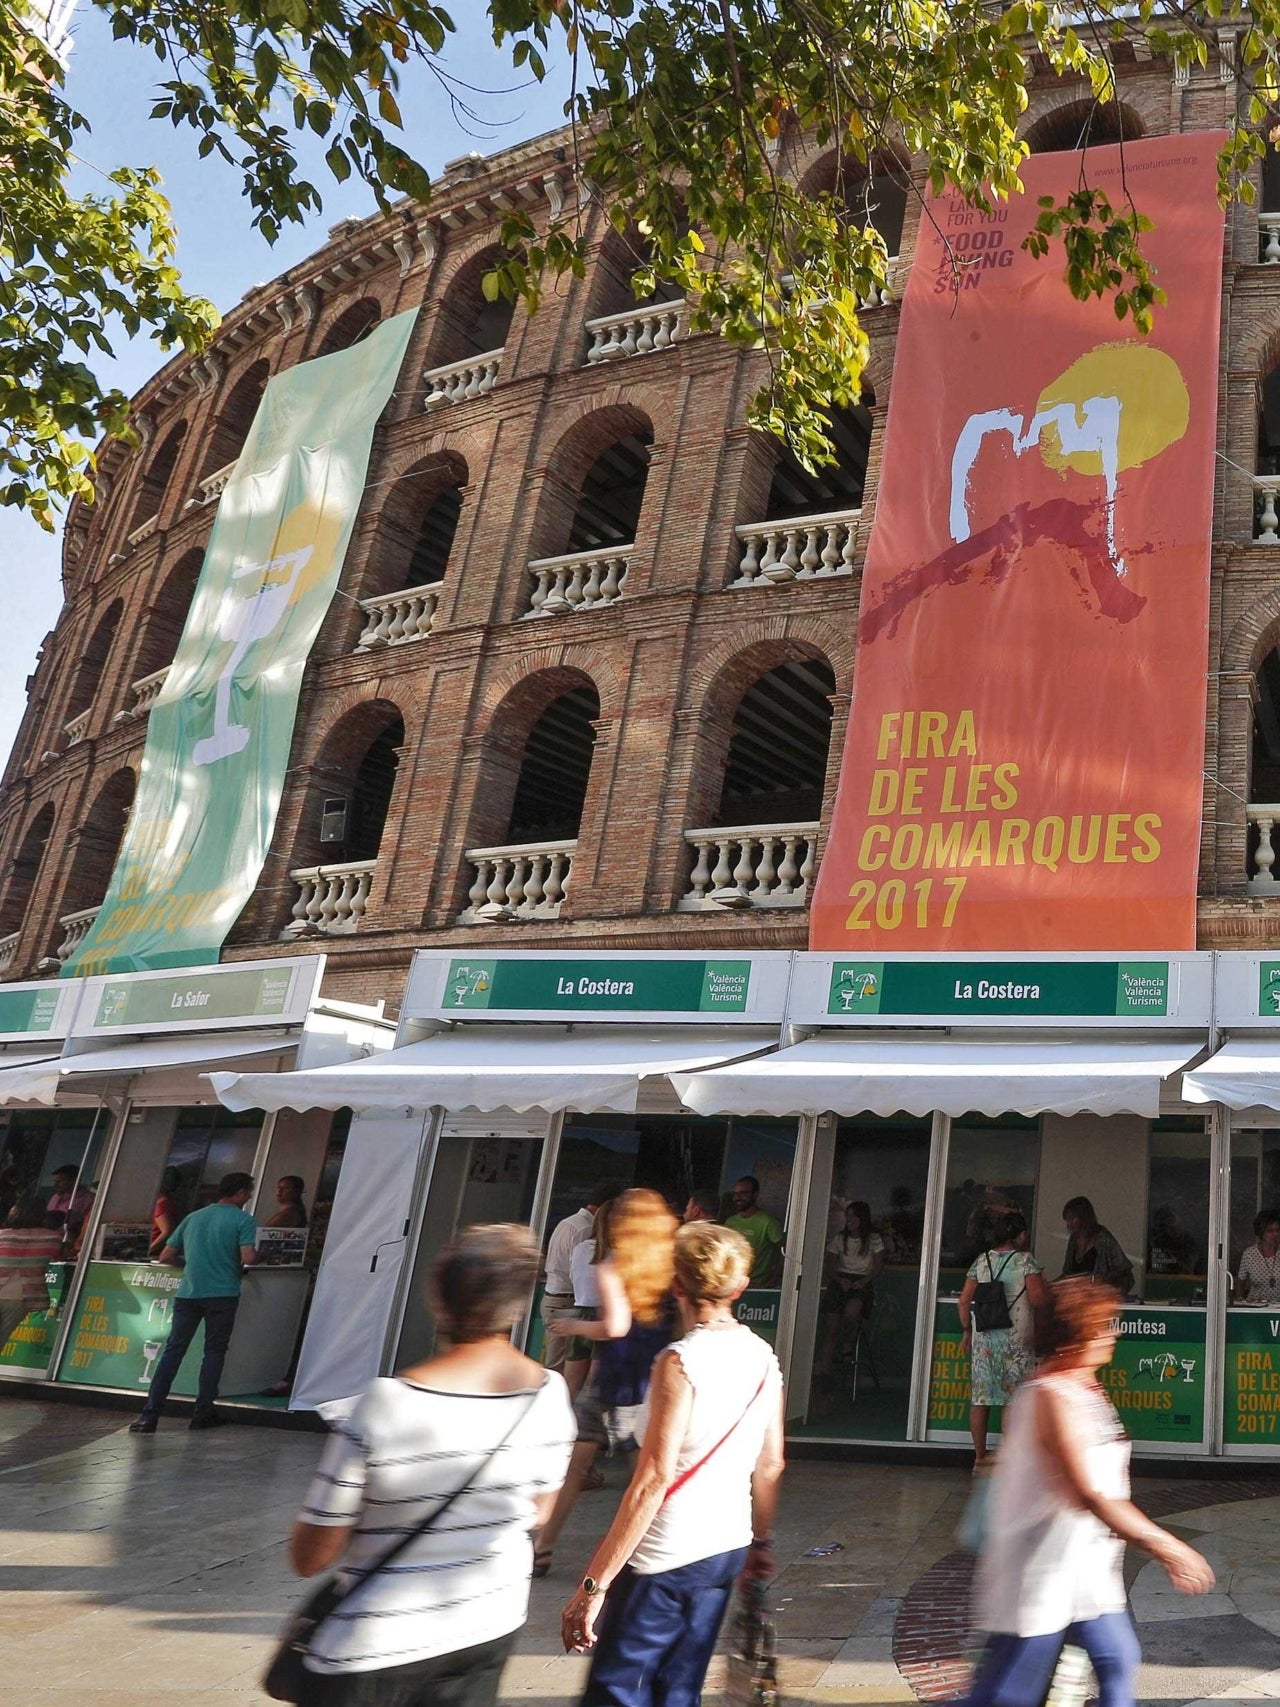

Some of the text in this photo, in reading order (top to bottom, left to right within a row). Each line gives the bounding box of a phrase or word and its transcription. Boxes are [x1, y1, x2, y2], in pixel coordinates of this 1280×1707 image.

[949, 200, 979, 214] LAN
[947, 209, 1008, 227] FOR YOU
[876, 709, 977, 761] FIRA
[867, 762, 1020, 816] DE LES
[857, 812, 1162, 873] COMARQUES
[845, 876, 967, 931] 2017
[556, 977, 634, 995] La Costera
[709, 983, 742, 992] València
[712, 974, 746, 984] València
[1127, 977, 1165, 986] València
[711, 993, 743, 1002] Turisme
[954, 980, 1041, 999] La Costera
[1124, 986, 1162, 996] València
[171, 991, 211, 1008] La Safor
[1127, 996, 1163, 1005] Turisme
[85, 1296, 106, 1313] FIRA
[737, 1303, 776, 1321] Canal
[79, 1314, 109, 1332] DE LES
[1109, 1317, 1166, 1335] Montesa
[75, 1332, 130, 1355] COMARQUES
[933, 1341, 967, 1360] FIRA
[69, 1351, 95, 1369] 2017
[1237, 1352, 1272, 1370] FIRA
[932, 1361, 971, 1379] DE LE
[1237, 1373, 1257, 1391] DE
[1110, 1389, 1172, 1411] ARQUES
[929, 1402, 966, 1420] 2017
[1237, 1414, 1277, 1433] 2017
